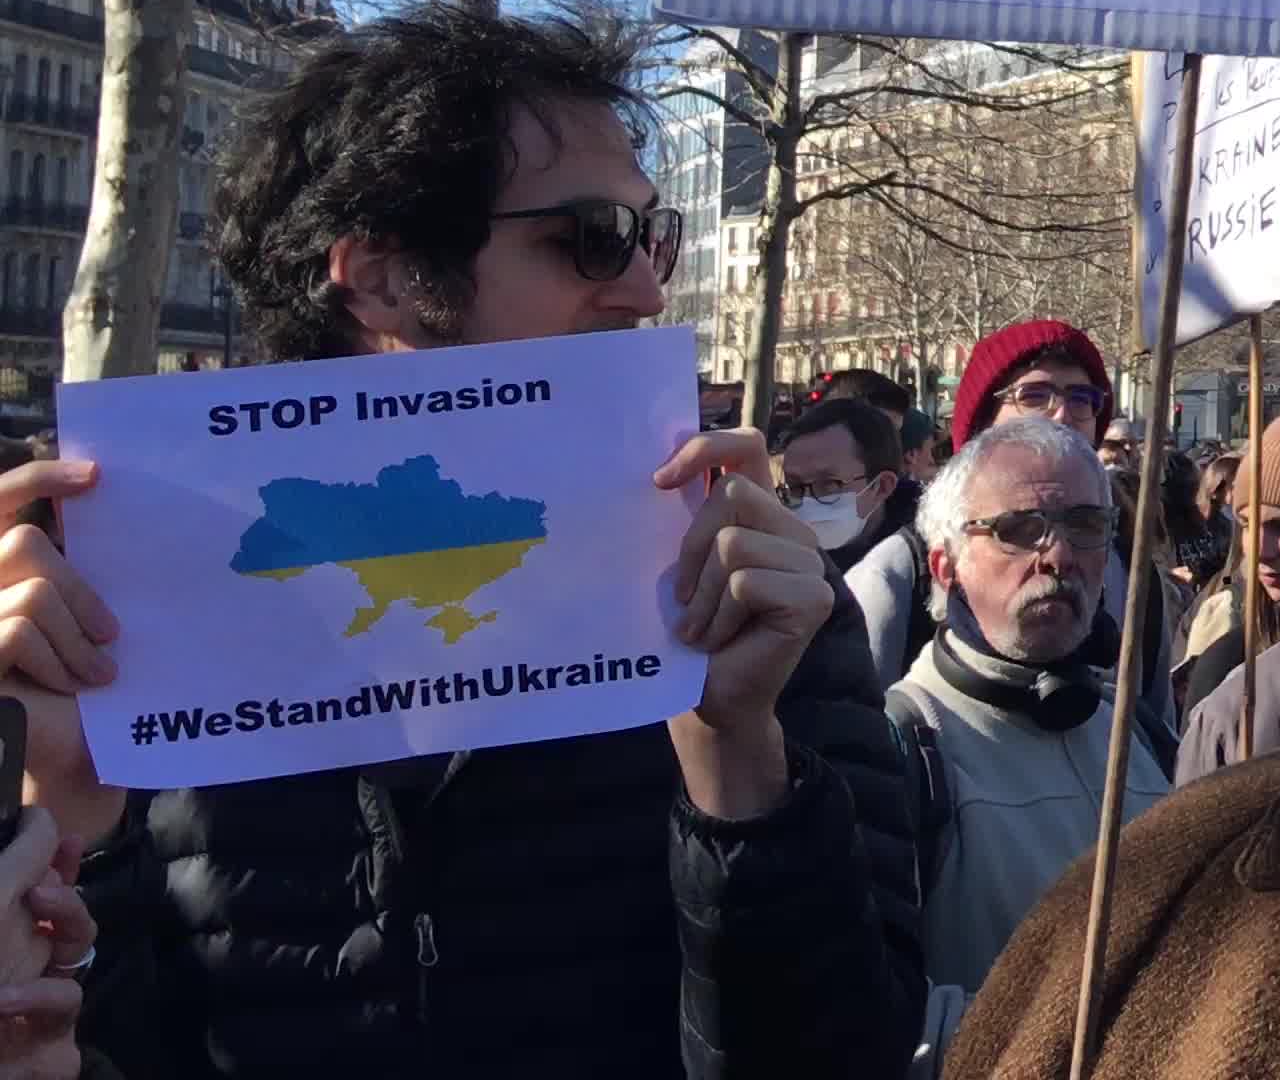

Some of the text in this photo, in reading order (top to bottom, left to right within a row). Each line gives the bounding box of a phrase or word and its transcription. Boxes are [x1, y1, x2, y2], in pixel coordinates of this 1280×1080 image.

[208, 375, 552, 436] STOP Invasion
[130, 652, 662, 747] #WeStandWithUkraine
